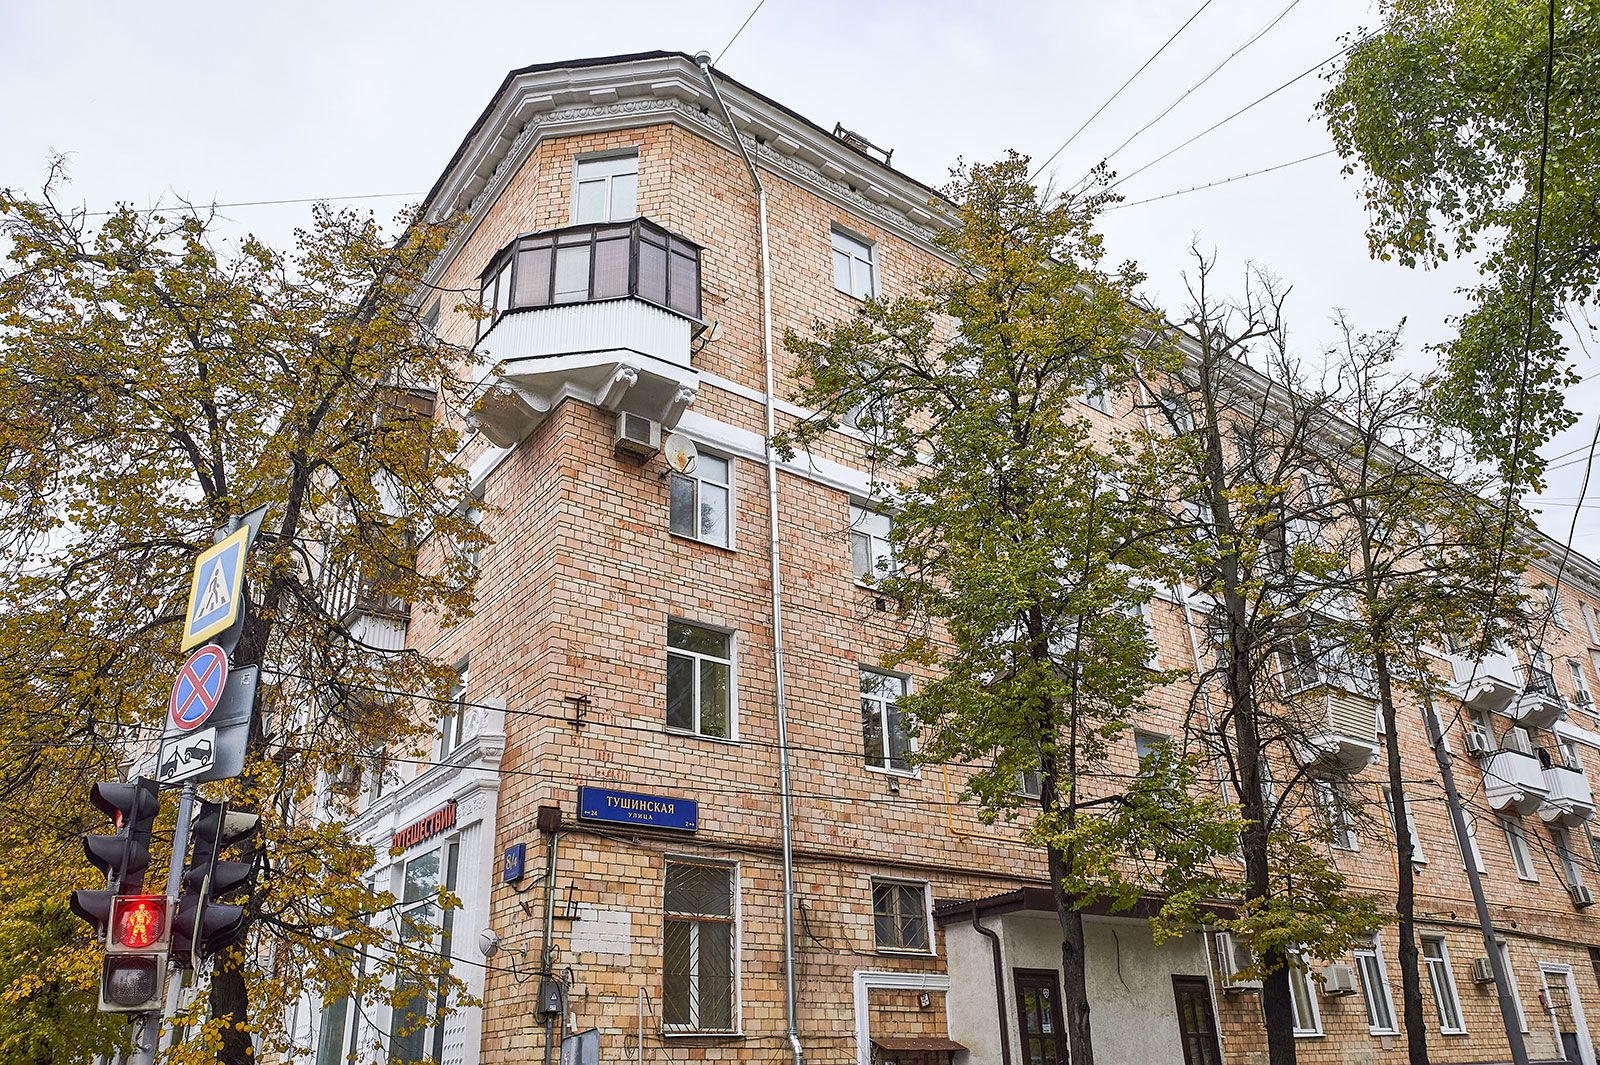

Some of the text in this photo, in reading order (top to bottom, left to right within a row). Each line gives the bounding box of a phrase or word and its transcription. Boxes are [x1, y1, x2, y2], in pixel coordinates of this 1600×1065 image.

[606, 796, 675, 814] ТУШИНСКАЯ
[628, 812, 653, 820] УЛИЦА
[505, 853, 518, 870] 8/4
